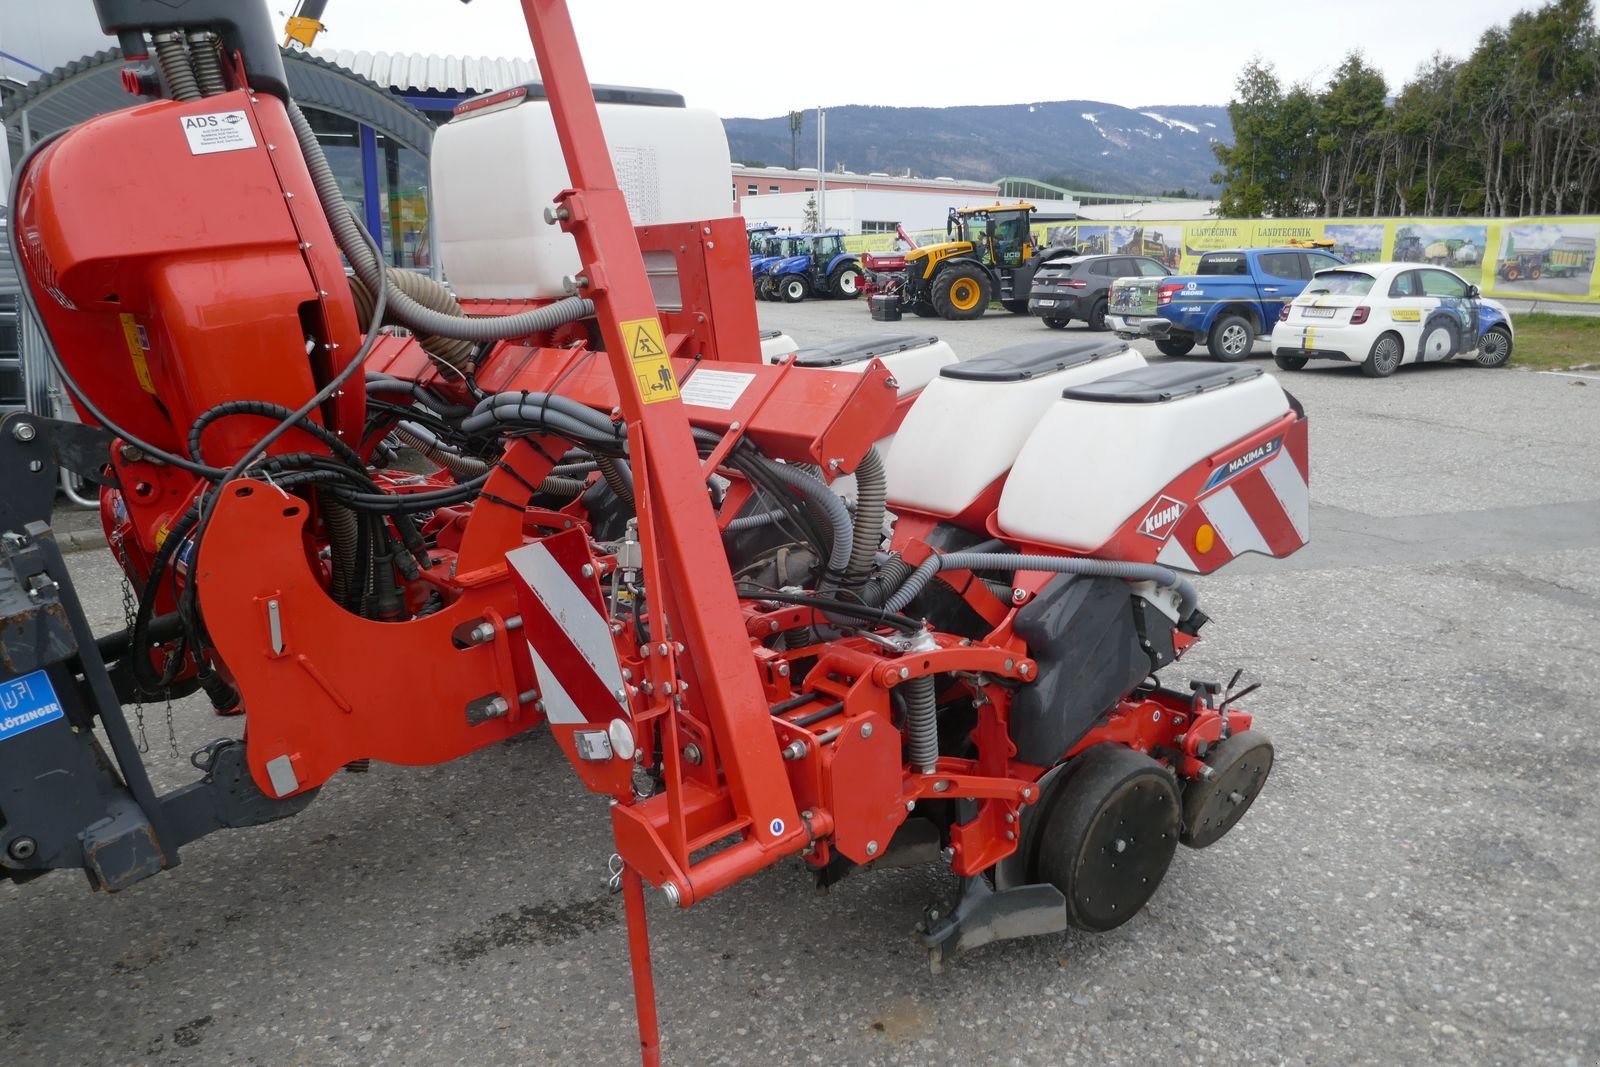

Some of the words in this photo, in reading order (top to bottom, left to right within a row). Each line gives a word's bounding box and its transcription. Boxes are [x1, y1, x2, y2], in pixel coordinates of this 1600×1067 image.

[186, 116, 218, 130] ADS
[1258, 227, 1311, 237] LANDTECHNIK
[1228, 447, 1264, 473] MAXIMA
[1265, 441, 1272, 452] 3
[1145, 503, 1181, 533] KUHN
